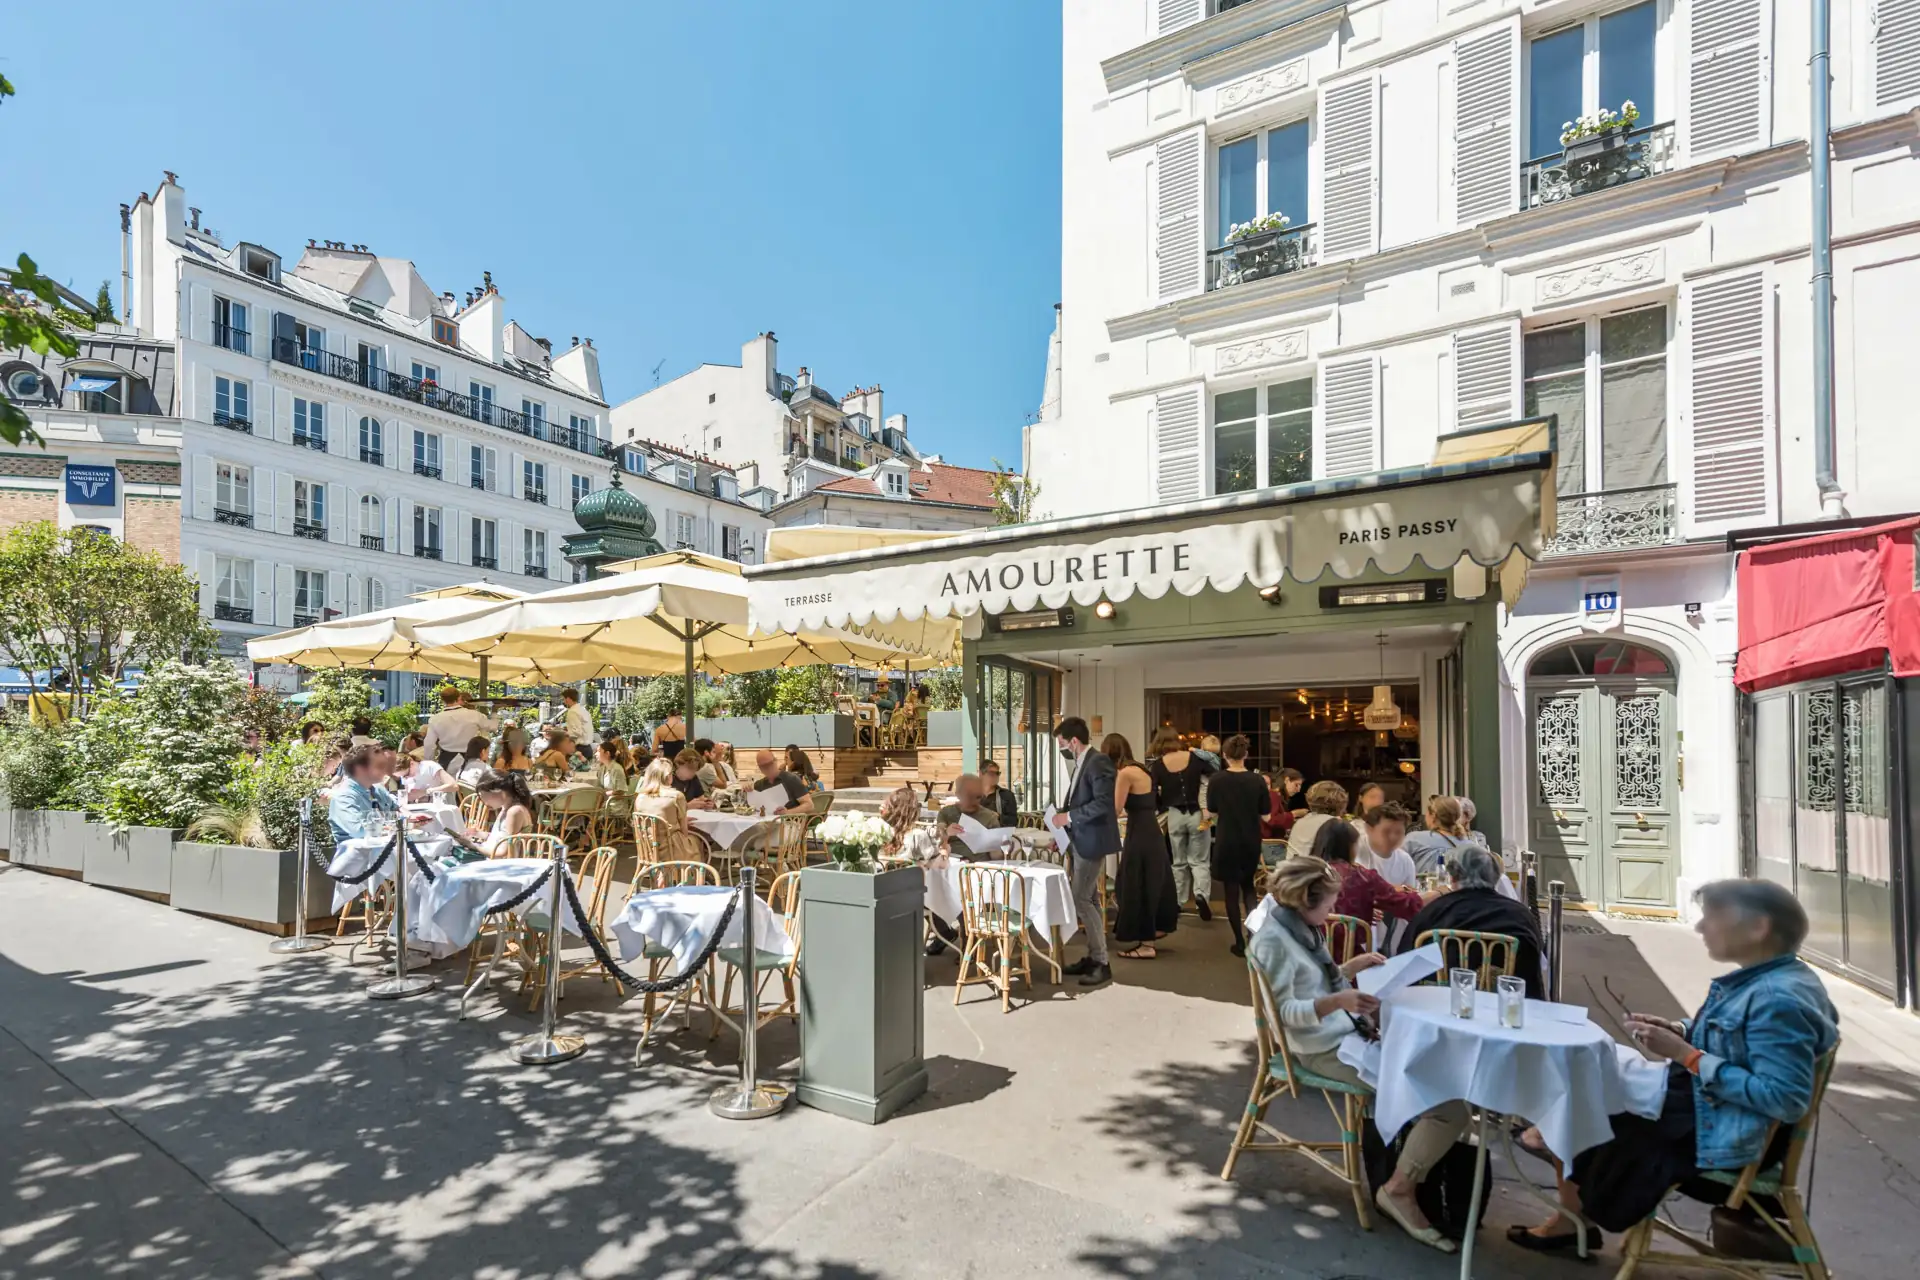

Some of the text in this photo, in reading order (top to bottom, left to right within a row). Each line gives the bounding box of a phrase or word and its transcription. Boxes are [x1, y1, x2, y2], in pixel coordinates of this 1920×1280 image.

[1339, 518, 1457, 545] PARIS PASSY
[940, 543, 1190, 597] AMOURETTE
[784, 592, 832, 607] TERRASSE
[1590, 593, 1612, 610] 10
